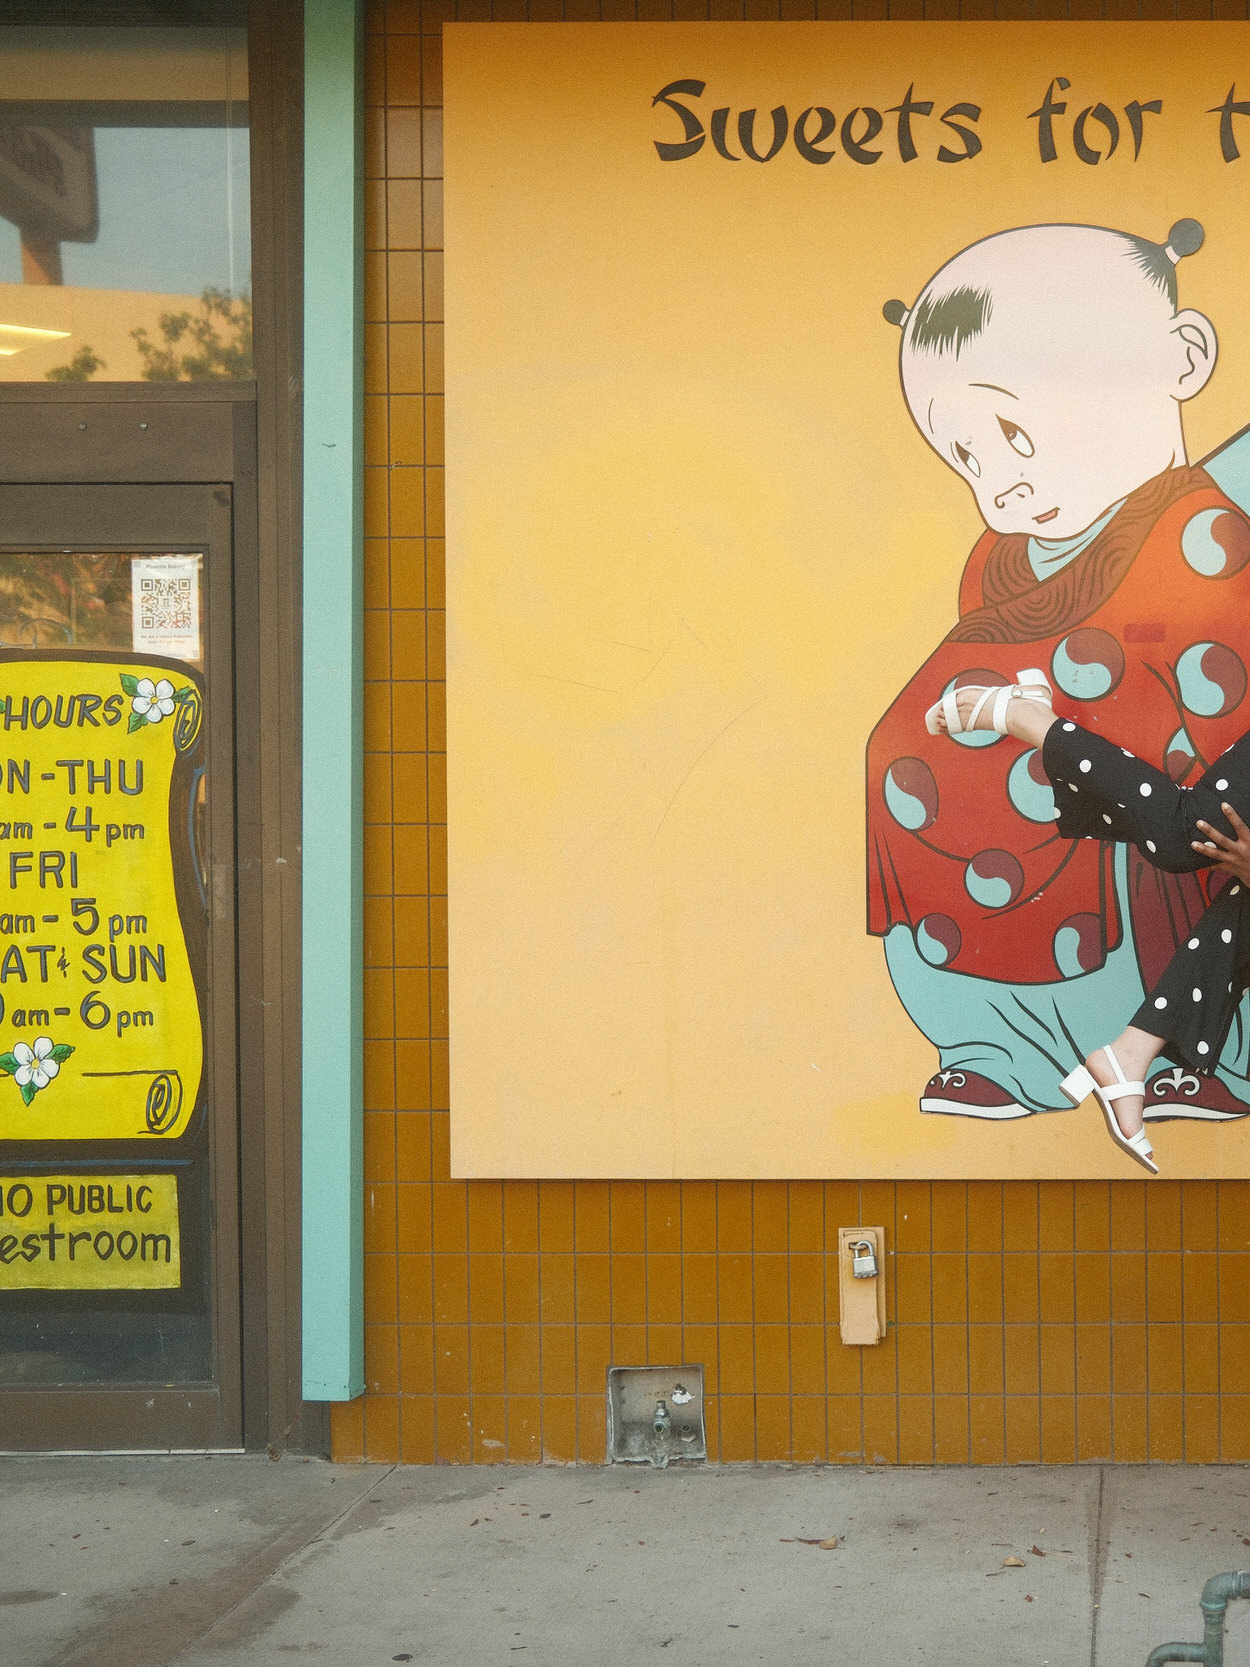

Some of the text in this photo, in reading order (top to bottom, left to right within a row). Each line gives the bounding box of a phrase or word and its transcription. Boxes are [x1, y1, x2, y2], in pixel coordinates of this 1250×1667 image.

[652, 79, 982, 165] Sweets
[1026, 77, 1163, 165] for
[4, 694, 124, 731] HOURS
[9, 850, 78, 889] FRI
[82, 943, 167, 984] SUN
[0, 1184, 153, 1217] O PUBLIC
